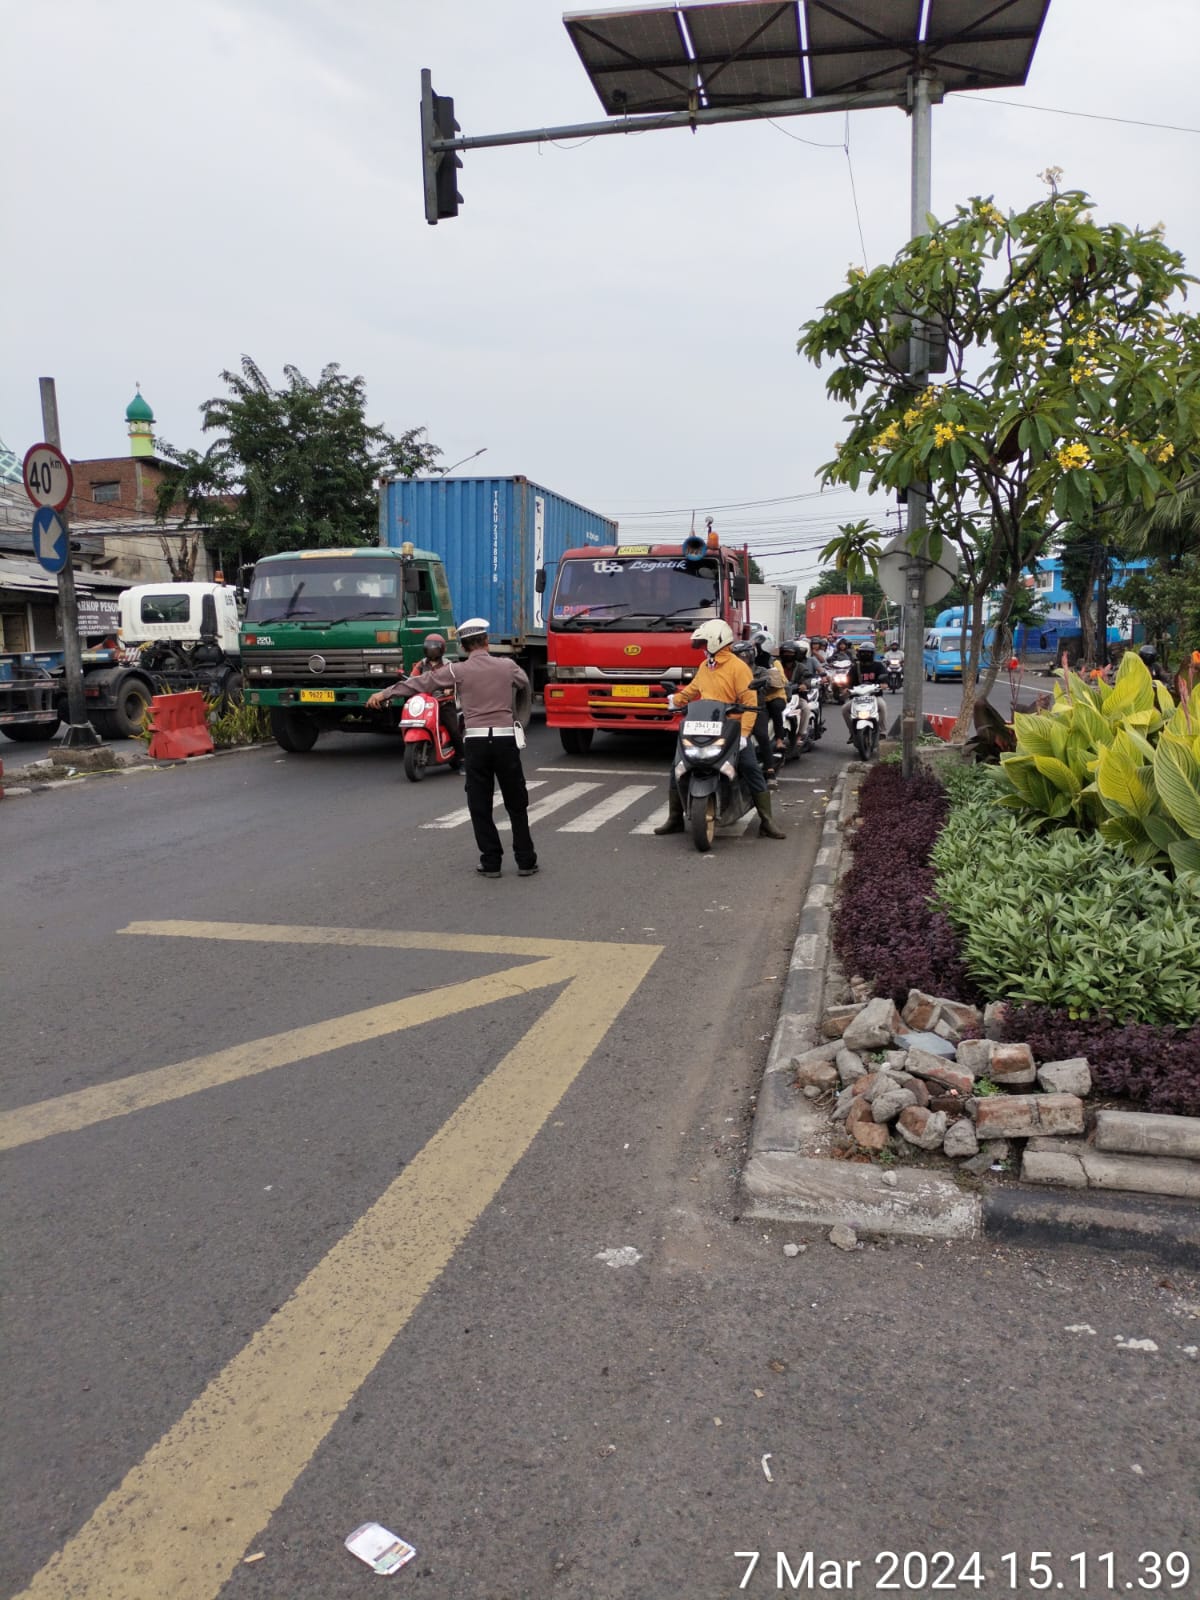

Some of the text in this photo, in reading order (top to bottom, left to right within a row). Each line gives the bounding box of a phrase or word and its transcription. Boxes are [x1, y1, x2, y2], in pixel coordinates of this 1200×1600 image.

[49, 457, 62, 469] km
[30, 461, 52, 494] 40
[628, 560, 687, 573] Logistik
